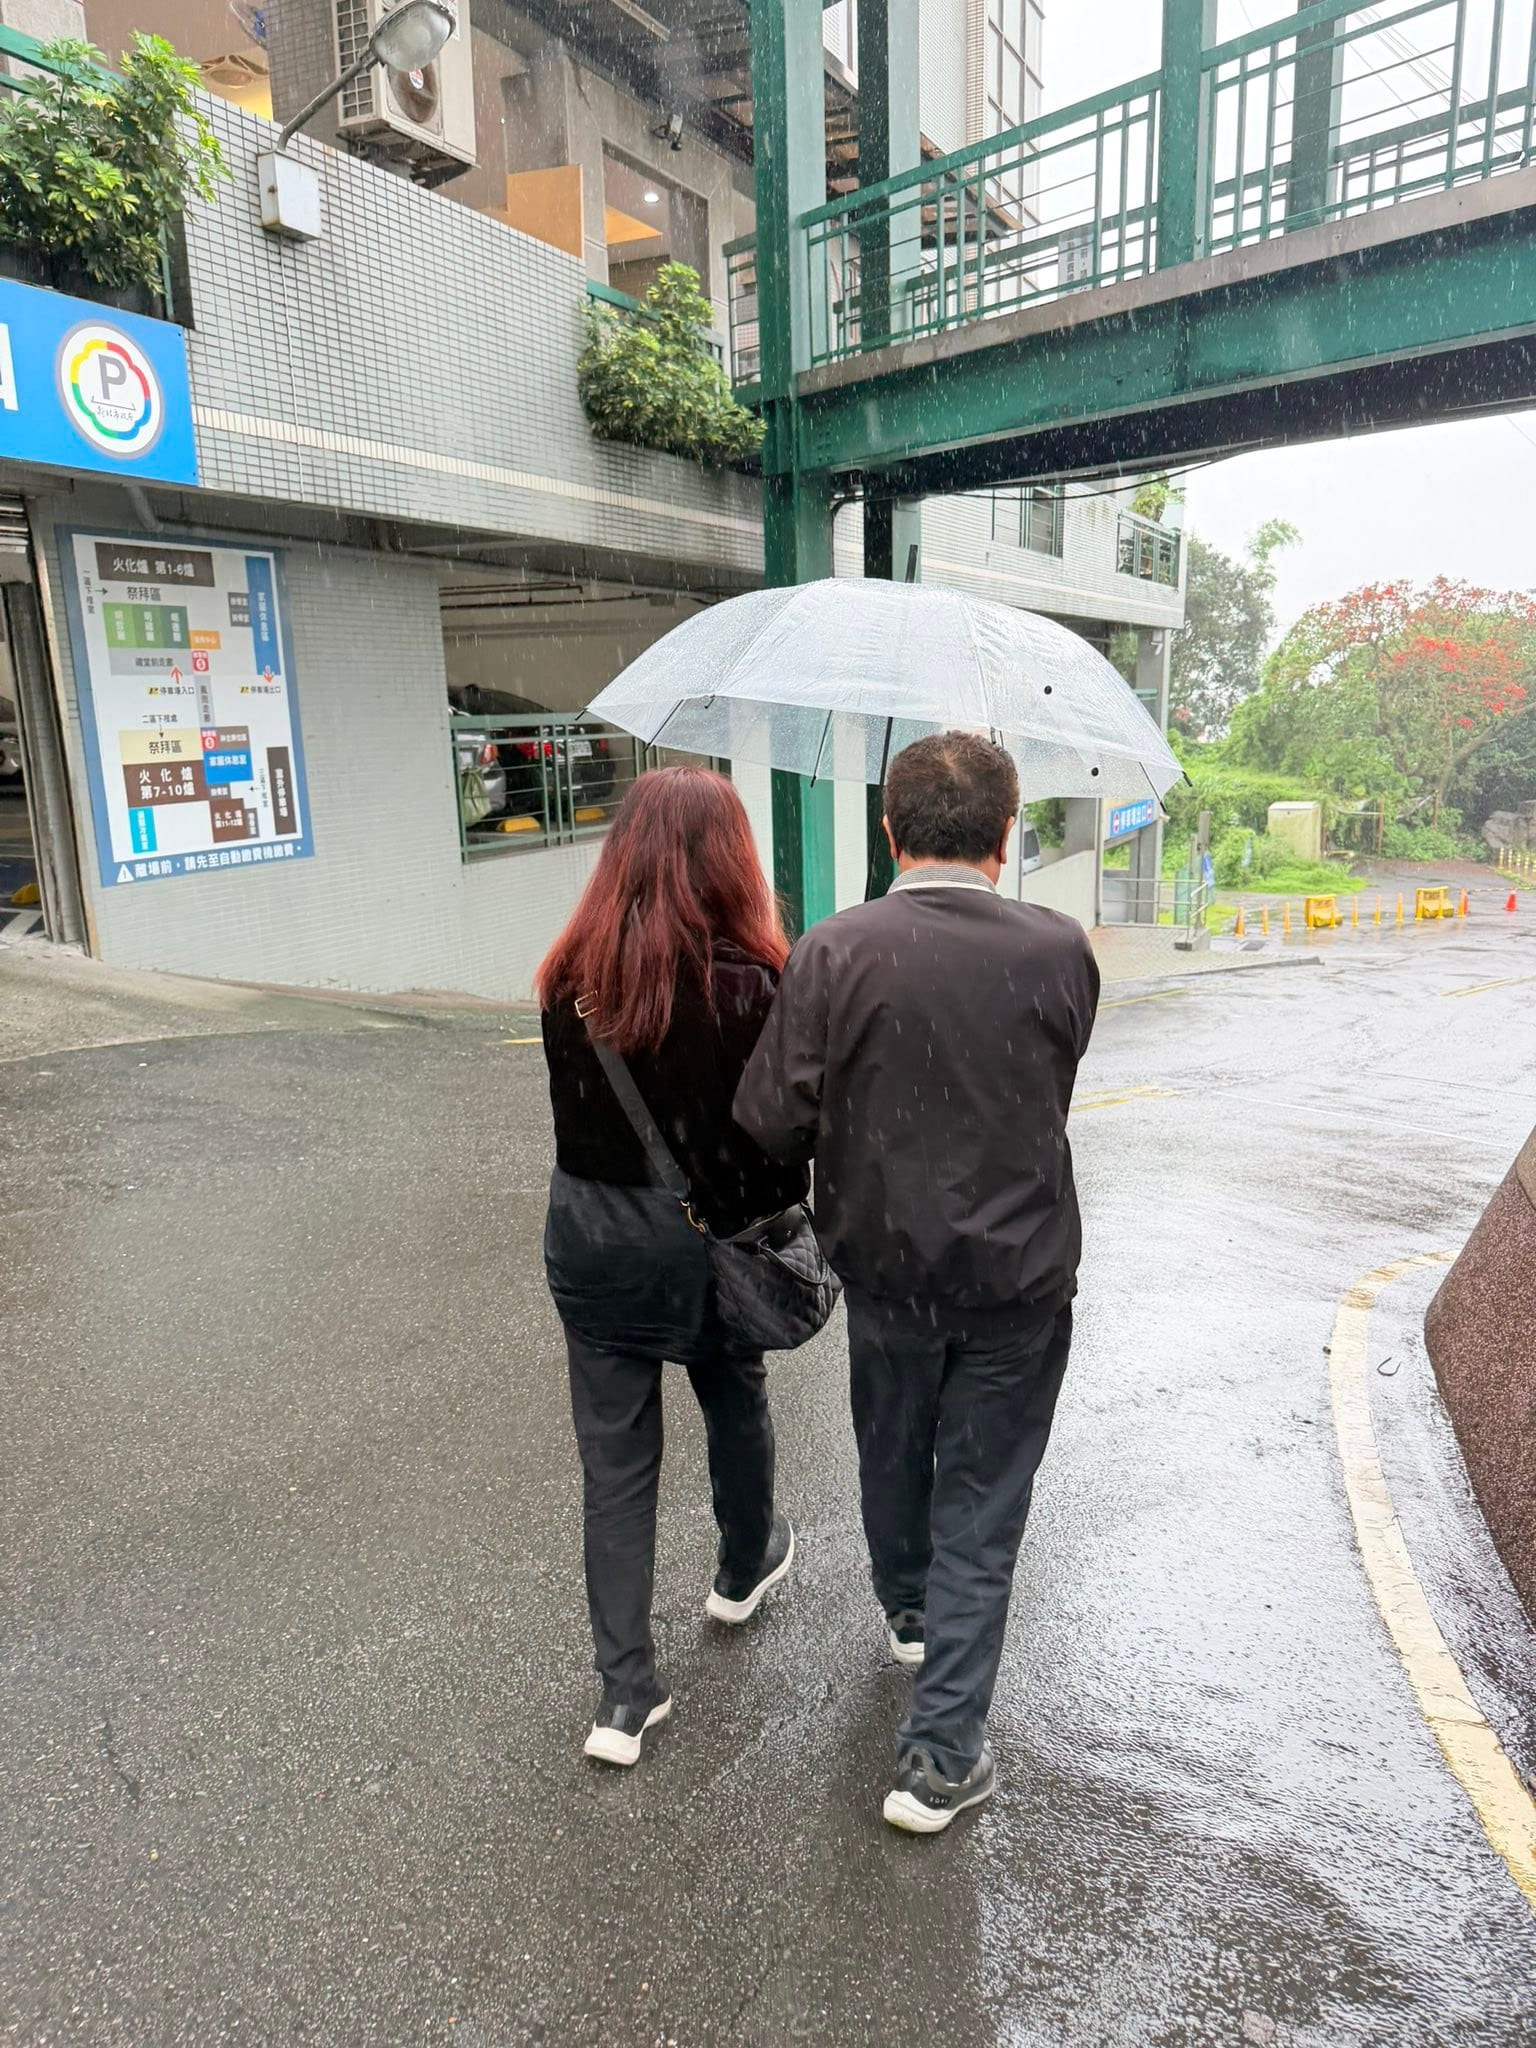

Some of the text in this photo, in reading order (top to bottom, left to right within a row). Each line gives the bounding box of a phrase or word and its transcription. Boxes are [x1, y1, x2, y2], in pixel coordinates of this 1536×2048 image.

[98, 354, 127, 400] P
[113, 557, 195, 577] 火化爐 第1-6爐
[127, 586, 161, 601] 祭拜區
[160, 687, 195, 695] 停車場入口
[251, 686, 281, 694] 停車場出口
[149, 739, 182, 755] 祭拜區
[209, 754, 247, 766] 家屬休息室
[139, 766, 193, 784] 火化爐
[140, 782, 195, 800] 第7-10爐
[275, 768, 288, 817] 室外停車場
